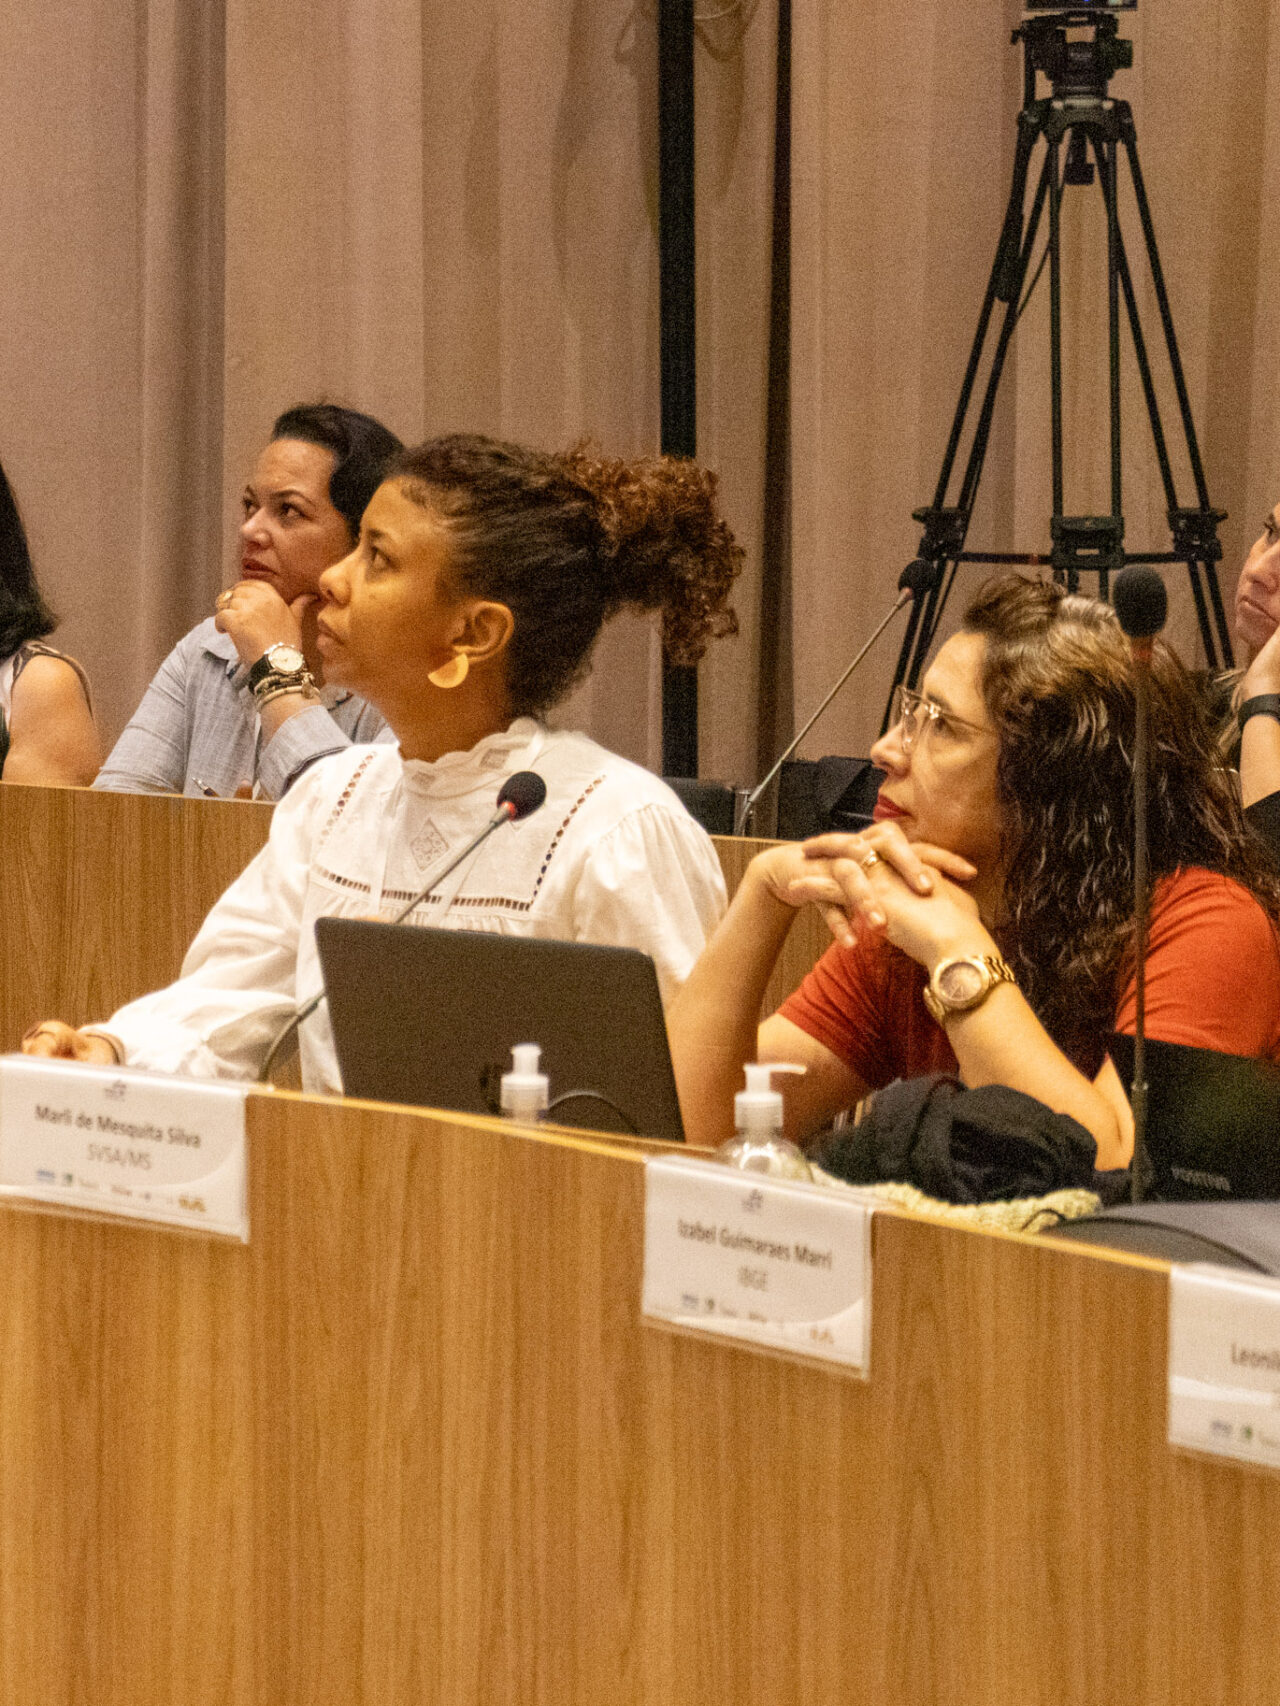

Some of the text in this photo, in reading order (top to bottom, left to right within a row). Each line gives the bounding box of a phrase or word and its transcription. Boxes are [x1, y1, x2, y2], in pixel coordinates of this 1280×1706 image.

[75, 1111, 94, 1130] de
[96, 1115, 164, 1143] Mesquita
[167, 1126, 202, 1148] Silva
